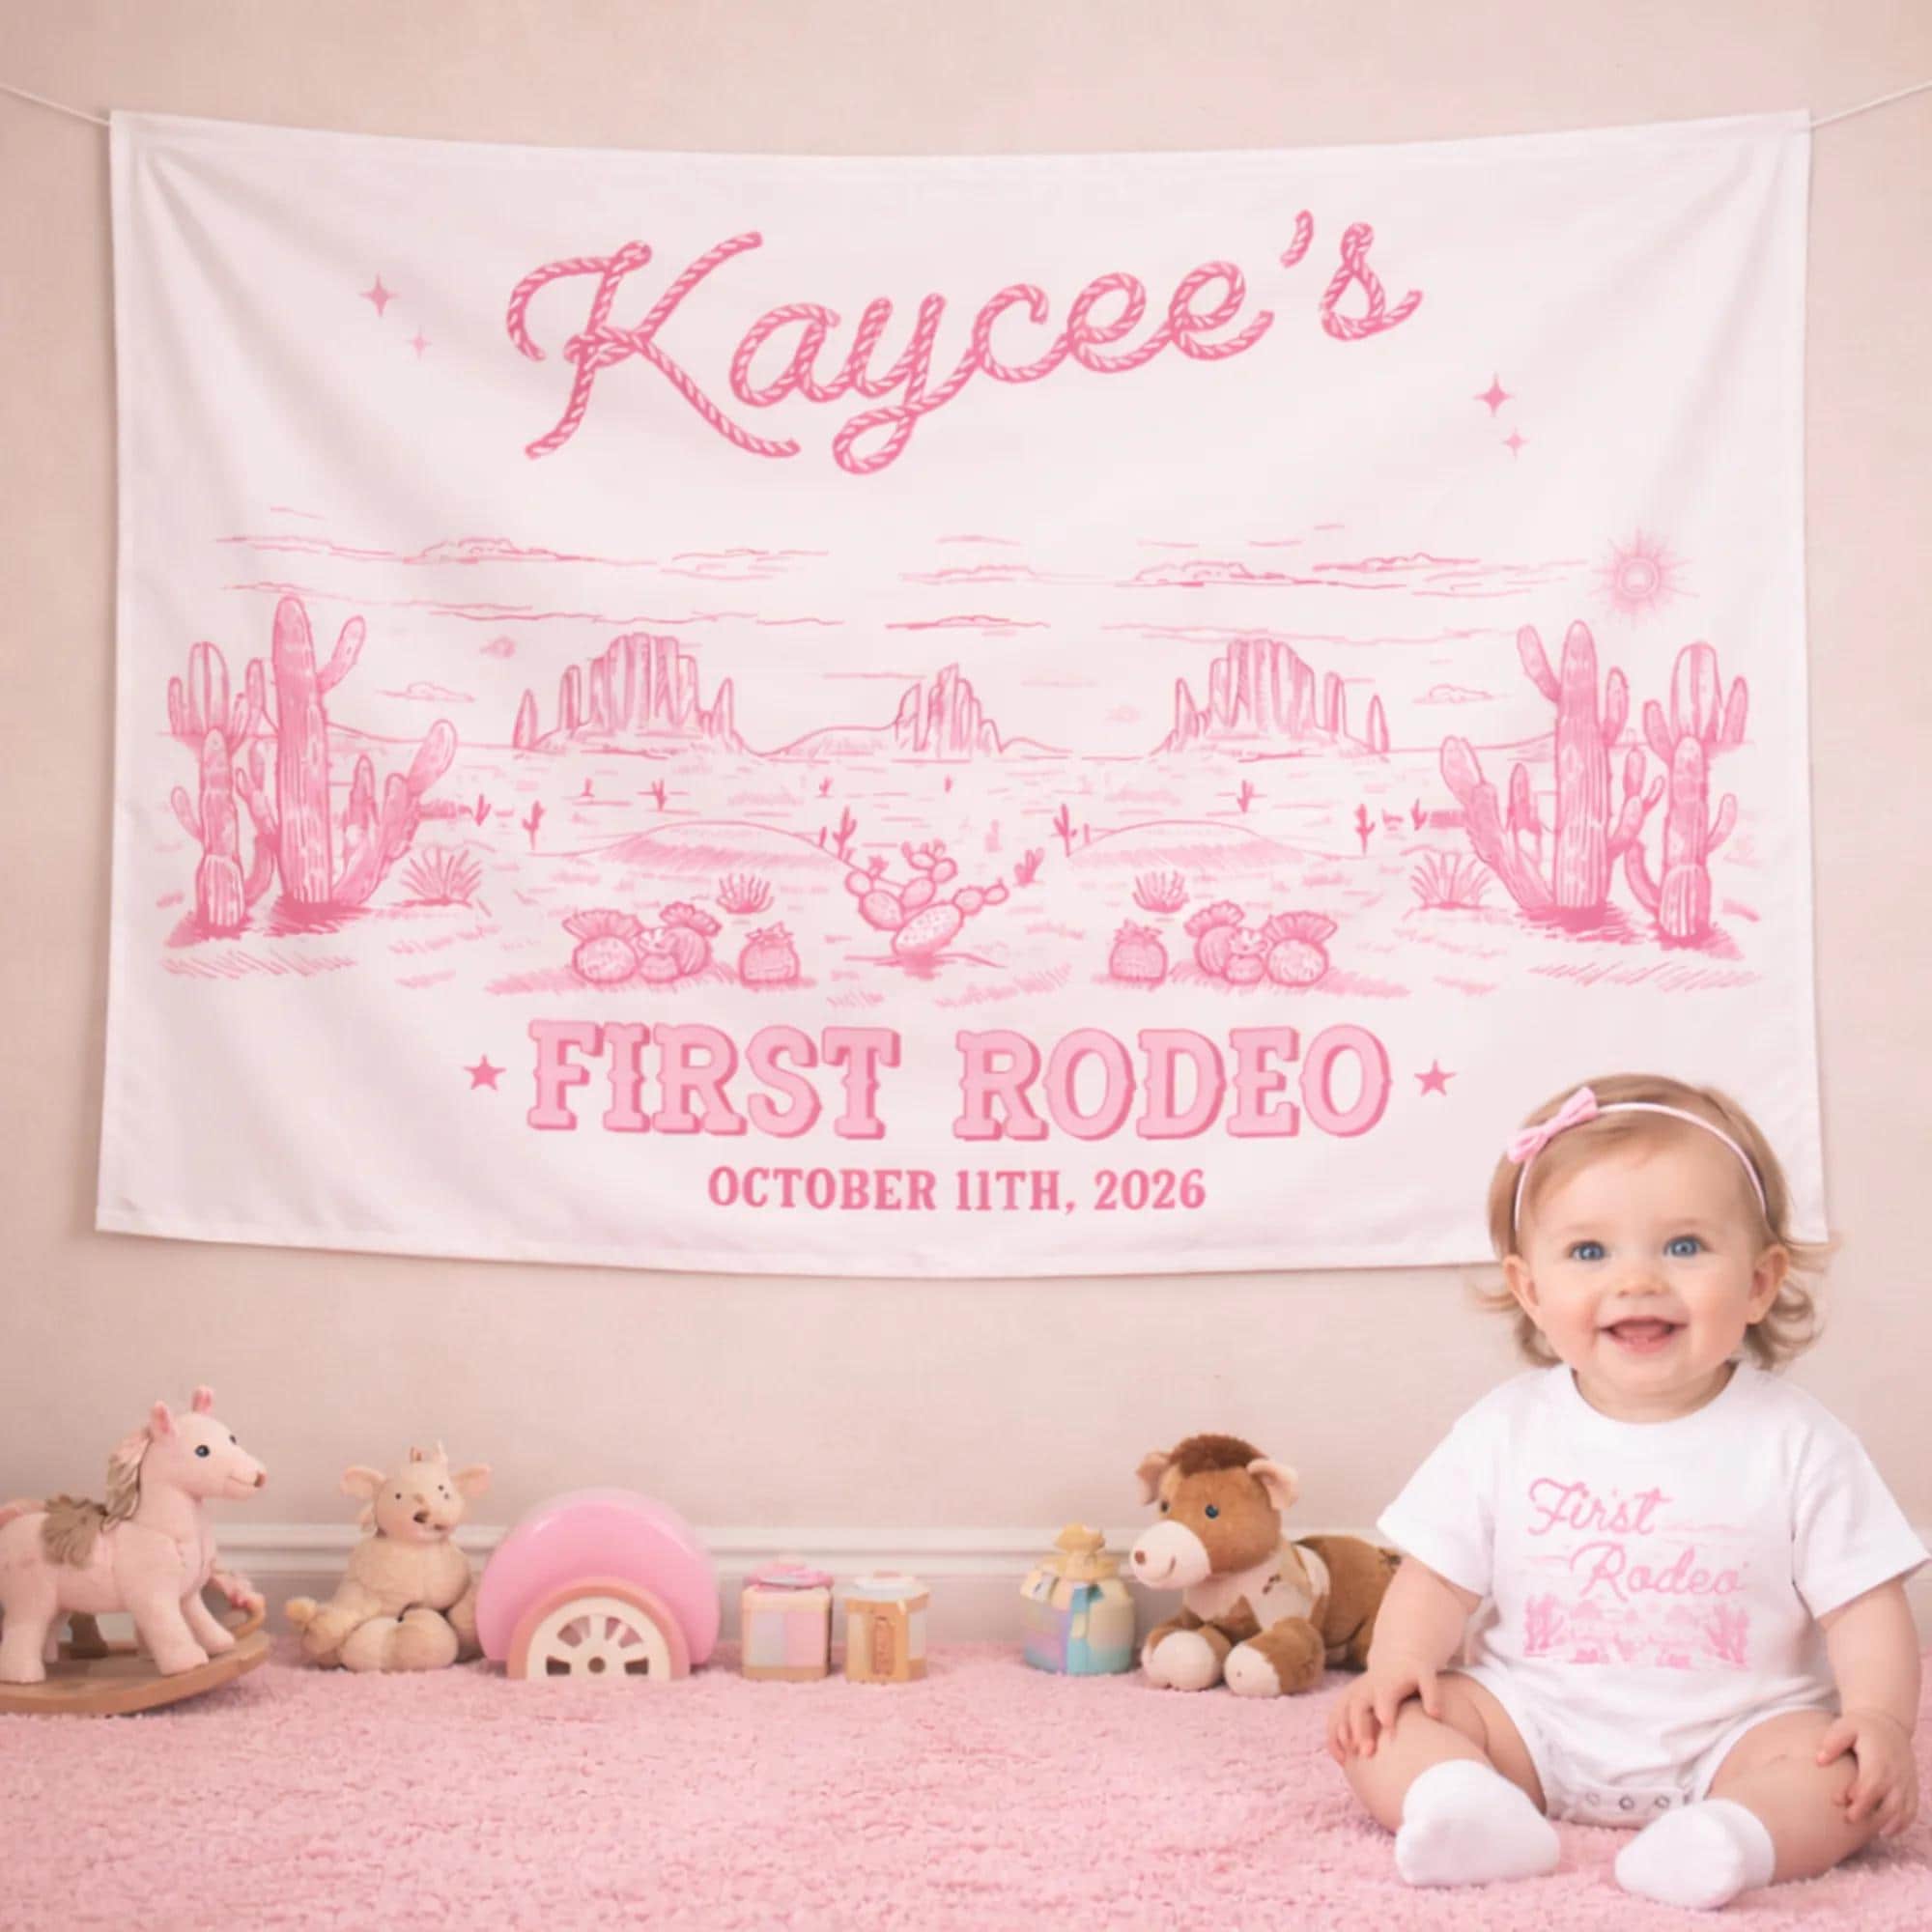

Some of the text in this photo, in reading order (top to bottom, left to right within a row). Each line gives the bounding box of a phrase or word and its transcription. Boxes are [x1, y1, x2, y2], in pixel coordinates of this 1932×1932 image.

[506, 210, 1424, 475] Kaycee's
[526, 1019, 1394, 1142] FIRST RODEO
[707, 1165, 1208, 1214] OCTOBER 11TH, 2026
[1527, 1477, 1673, 1536] First
[1568, 1540, 1747, 1604] Rodeo
